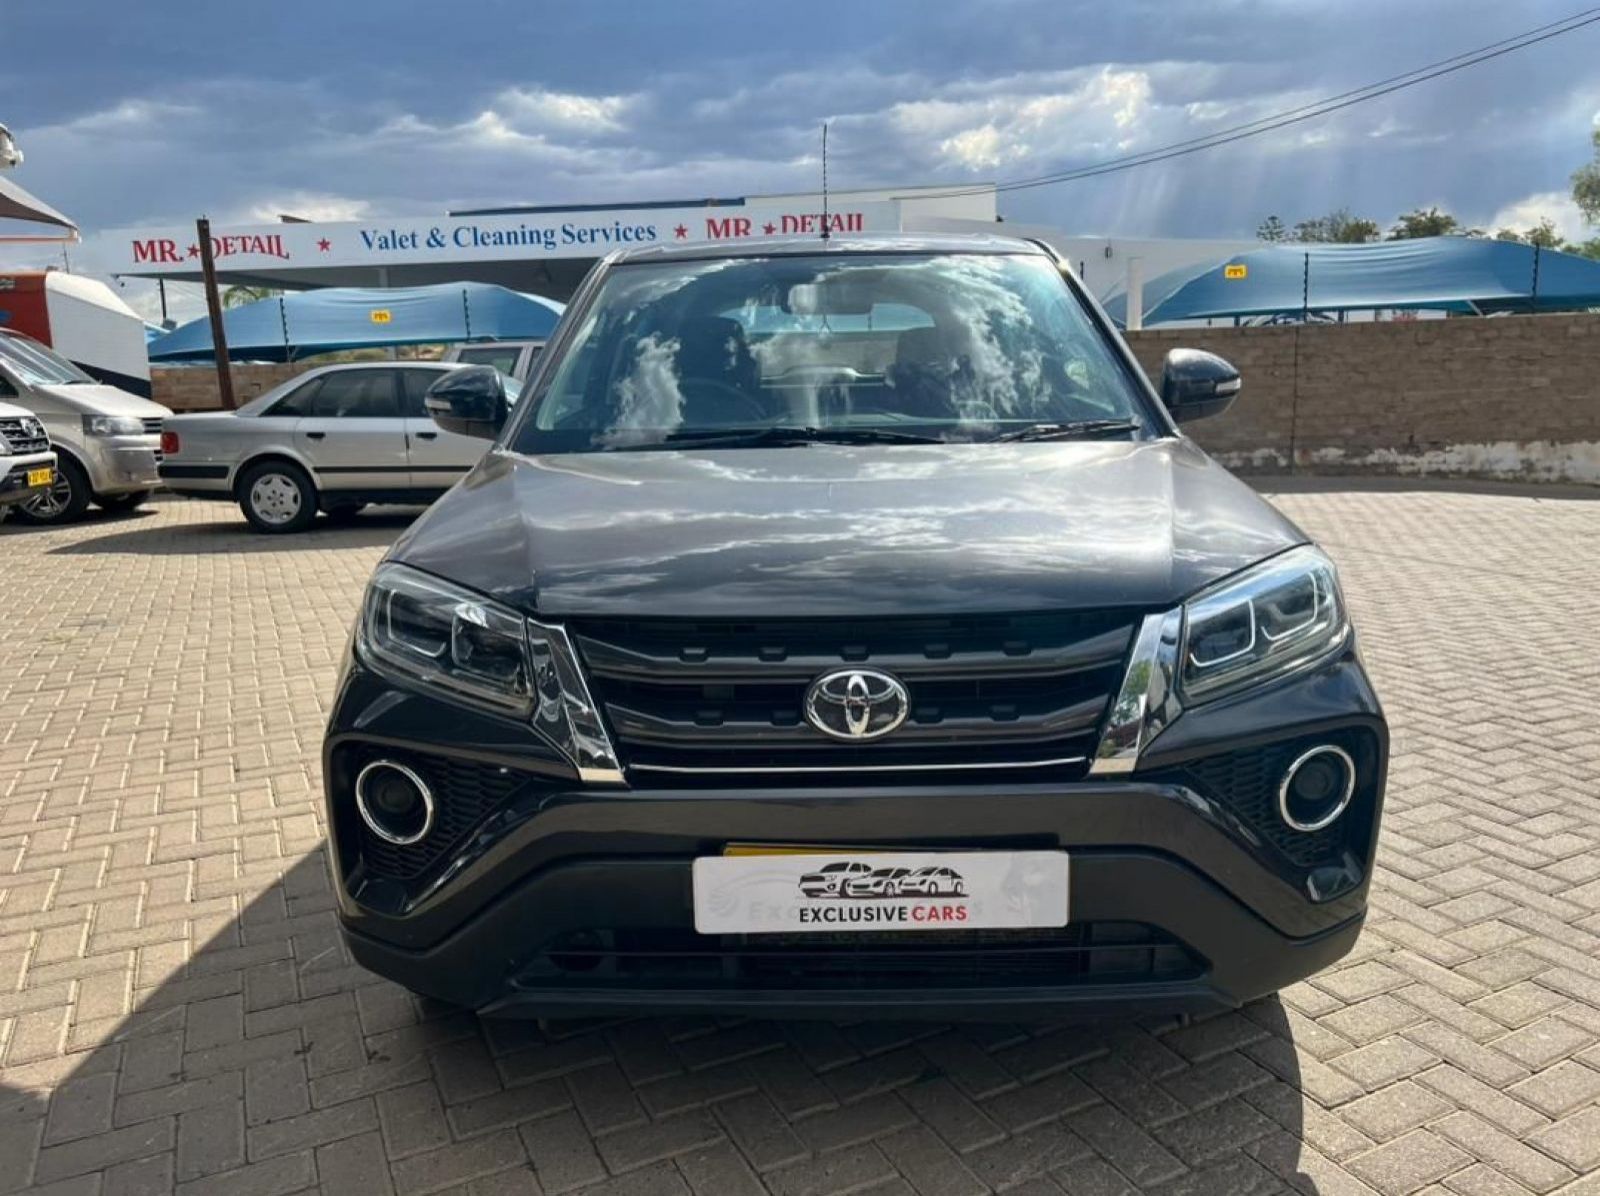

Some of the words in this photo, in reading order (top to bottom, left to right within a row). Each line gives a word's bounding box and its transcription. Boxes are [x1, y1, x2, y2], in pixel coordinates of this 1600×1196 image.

[131, 239, 185, 263] MR.
[360, 229, 419, 250] Valet
[426, 227, 446, 248] &
[453, 224, 557, 250] Cleaning
[561, 220, 657, 245] Services
[799, 906, 908, 924] EXCLUSIVE
[911, 905, 967, 922] CARS
